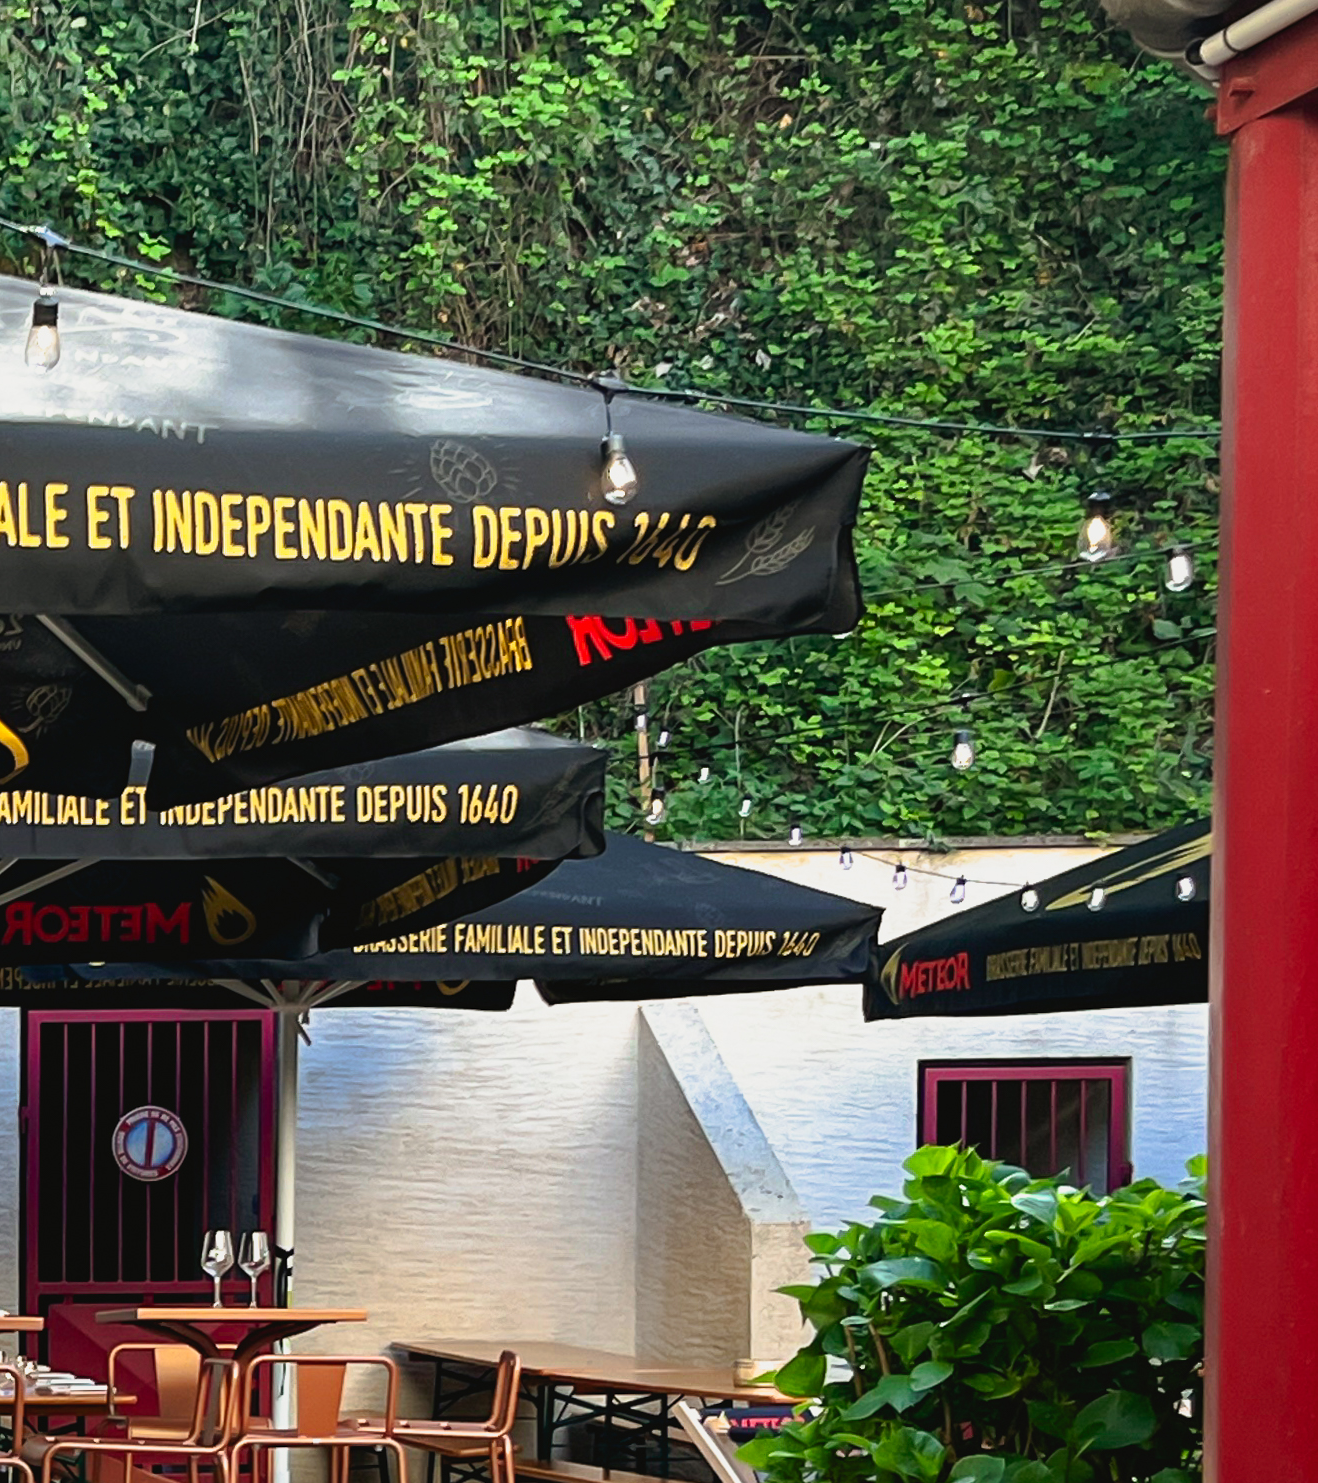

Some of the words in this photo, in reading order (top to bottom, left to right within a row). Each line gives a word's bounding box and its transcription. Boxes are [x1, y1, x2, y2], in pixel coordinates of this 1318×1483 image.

[88, 484, 136, 549] ET
[153, 489, 453, 568] INDEPENDANTE
[473, 503, 616, 571] DEPUIS
[616, 511, 717, 572] 1640
[120, 785, 147, 826] ET
[356, 784, 448, 823] DEPUIS
[458, 783, 519, 824] 1640
[454, 923, 546, 955] FAMILIALE
[551, 926, 573, 955] ET
[579, 927, 708, 958] INDEPENDANTE
[715, 929, 777, 959] DEPUIS
[777, 931, 821, 957] 1640
[899, 952, 971, 999] METEOR
